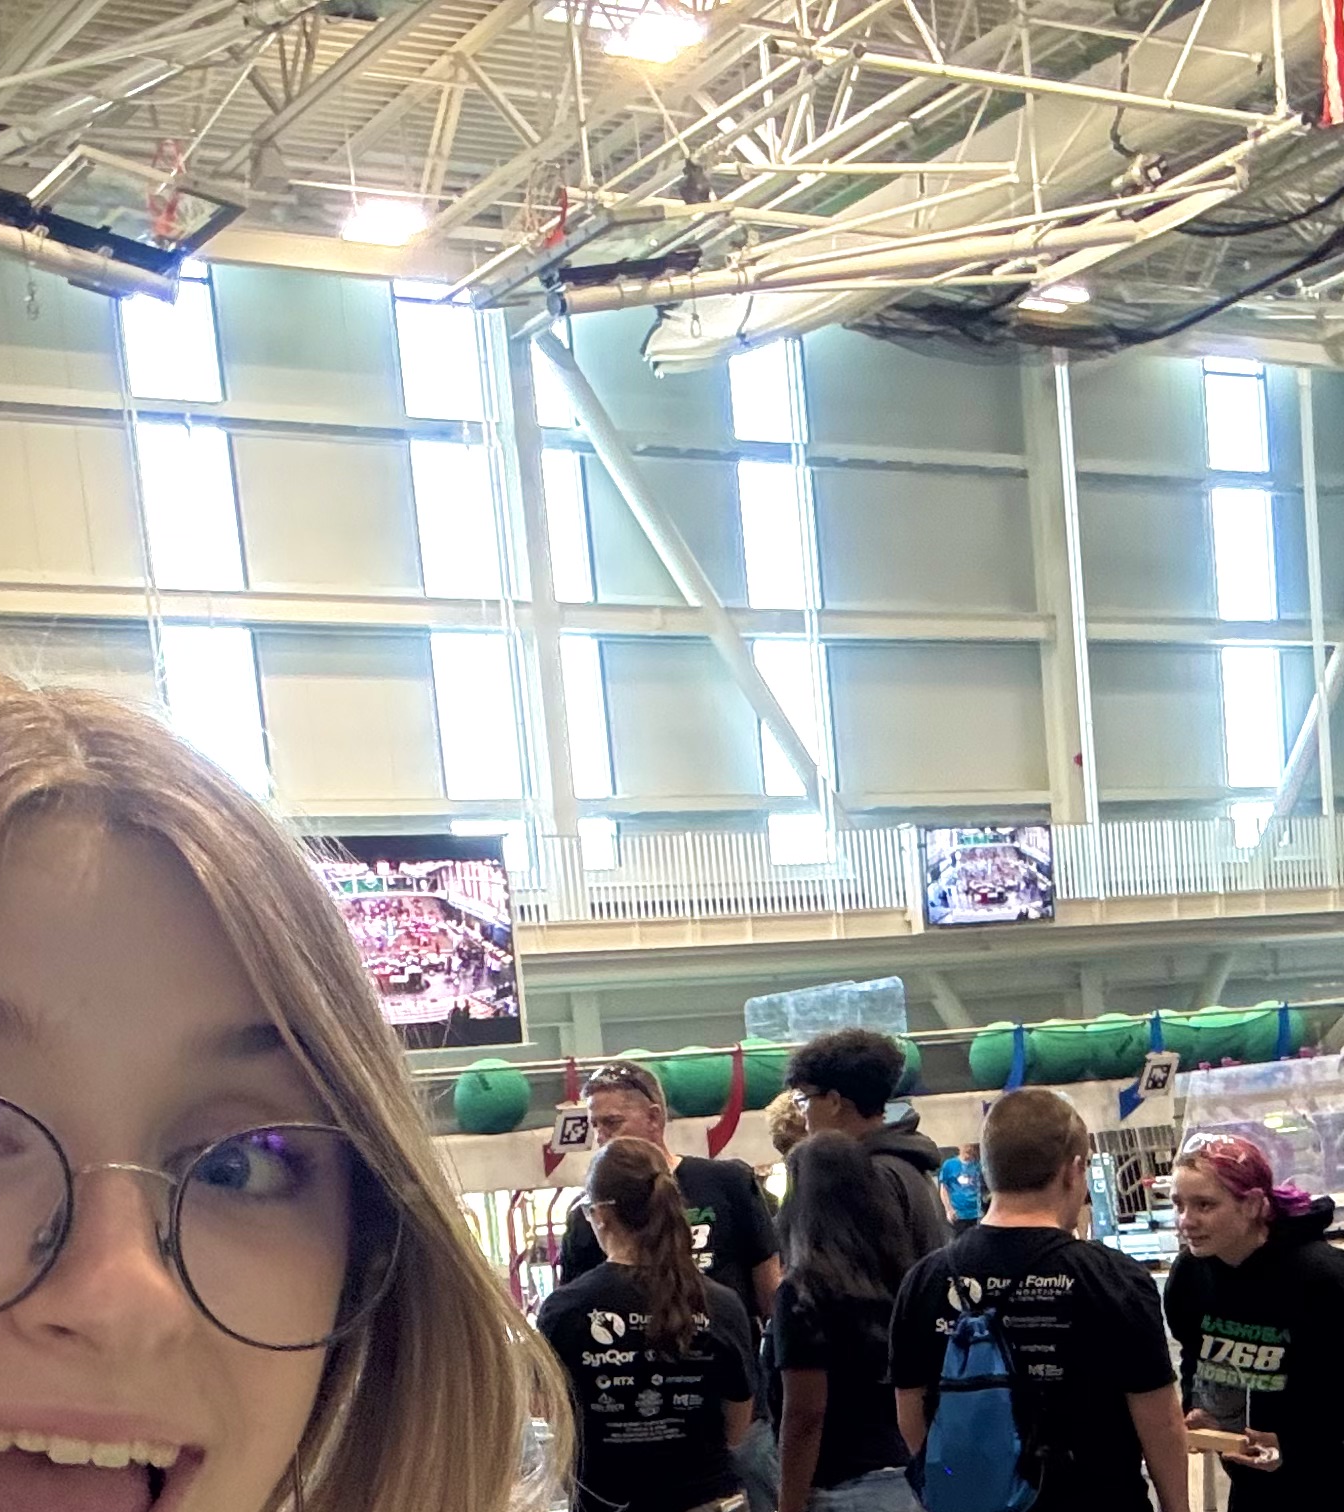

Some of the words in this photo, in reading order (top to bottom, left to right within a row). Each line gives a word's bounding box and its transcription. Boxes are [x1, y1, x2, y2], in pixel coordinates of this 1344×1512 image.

[1025, 1274, 1075, 1290] Family
[582, 1350, 636, 1367] SynQor
[1200, 1334, 1286, 1371] 1768
[613, 1376, 635, 1386] RTX
